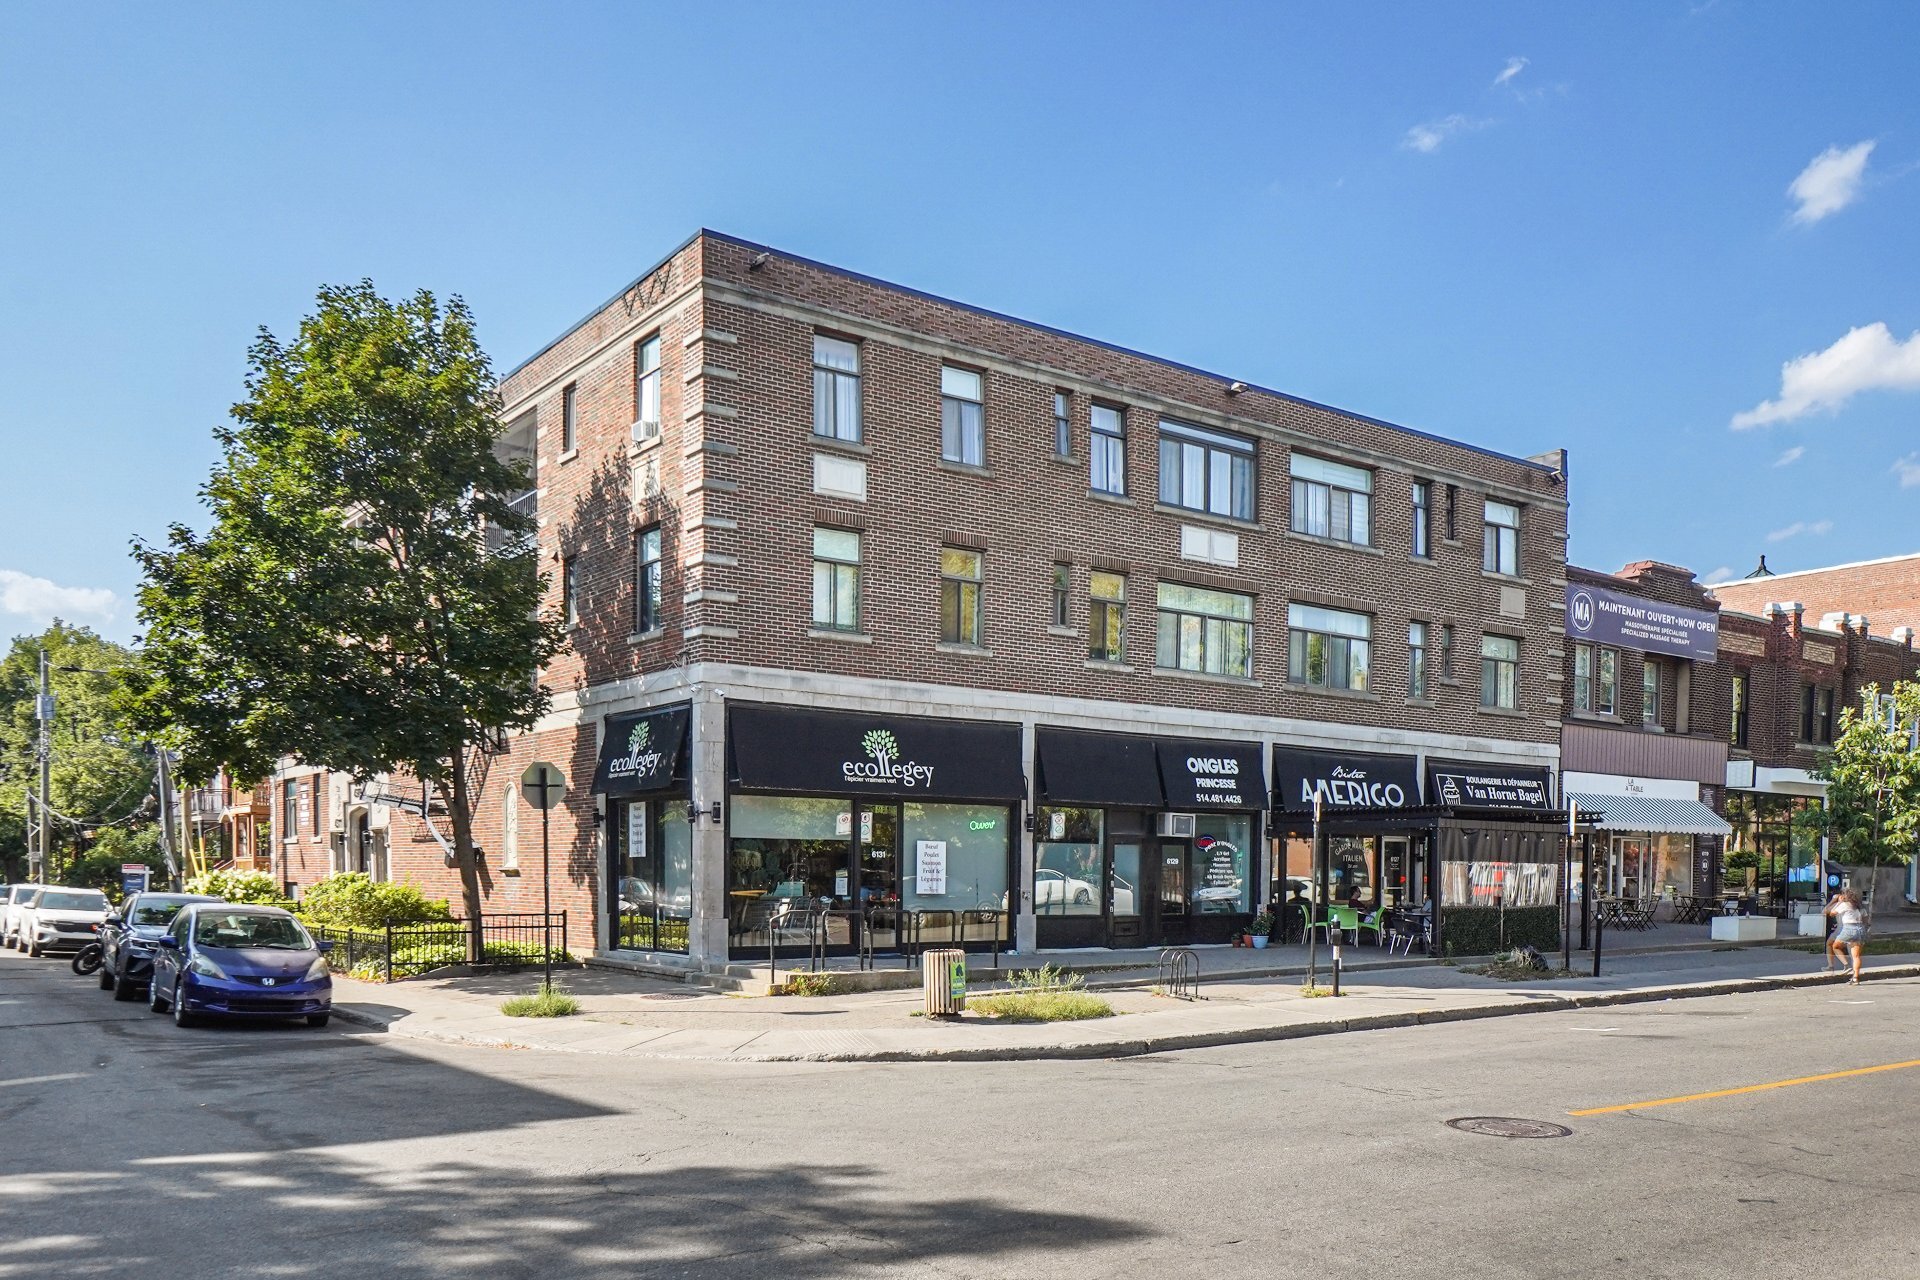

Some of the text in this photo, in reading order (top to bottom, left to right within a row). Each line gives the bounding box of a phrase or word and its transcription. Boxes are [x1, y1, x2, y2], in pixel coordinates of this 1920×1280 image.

[1598, 600, 1645, 620] MAINTENANT
[1697, 621, 1716, 633] OPEN
[1624, 620, 1660, 633] MASSOTHÉRAPIE
[1620, 627, 1690, 646] SPECIALIZED MASSAGE THERAPY
[610, 749, 662, 777] ecollegey
[1186, 757, 1239, 775] ONGLES
[1331, 765, 1367, 779] Bistro
[842, 760, 935, 788] ecollegey
[1195, 777, 1237, 789] PRINCESSE
[1466, 776, 1502, 786] BOULANGERIE
[1507, 778, 1539, 788] DÉPANNEUR
[1195, 793, 1242, 804] 514.481.4426
[1302, 778, 1405, 807] AMERIGO
[1466, 785, 1544, 805] Van Horne Bagel
[871, 850, 886, 858] 6131
